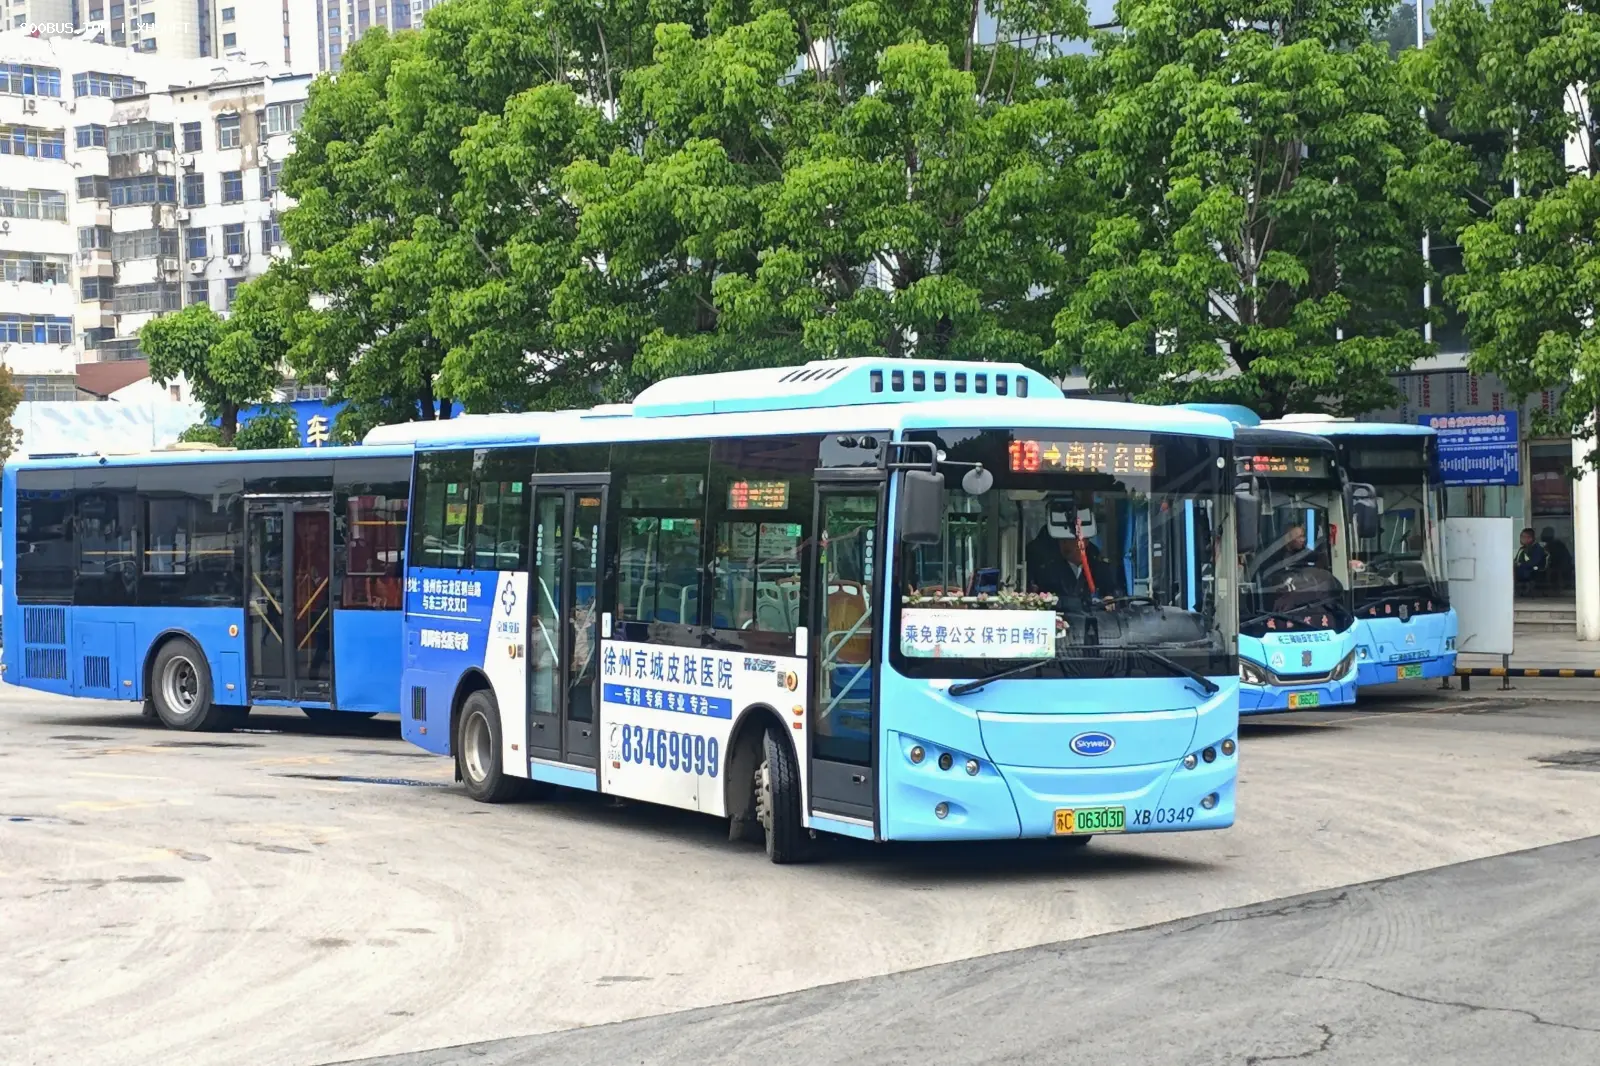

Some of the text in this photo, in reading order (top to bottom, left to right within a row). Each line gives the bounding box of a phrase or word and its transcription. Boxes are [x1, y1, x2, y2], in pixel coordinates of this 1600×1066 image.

[905, 625, 1049, 645] 乘免费公交 保节日畅行
[604, 646, 733, 690] 徐州京城皮肤医院
[645, 690, 663, 709] 专病
[667, 692, 685, 711] 专业
[621, 724, 719, 777] 83469999
